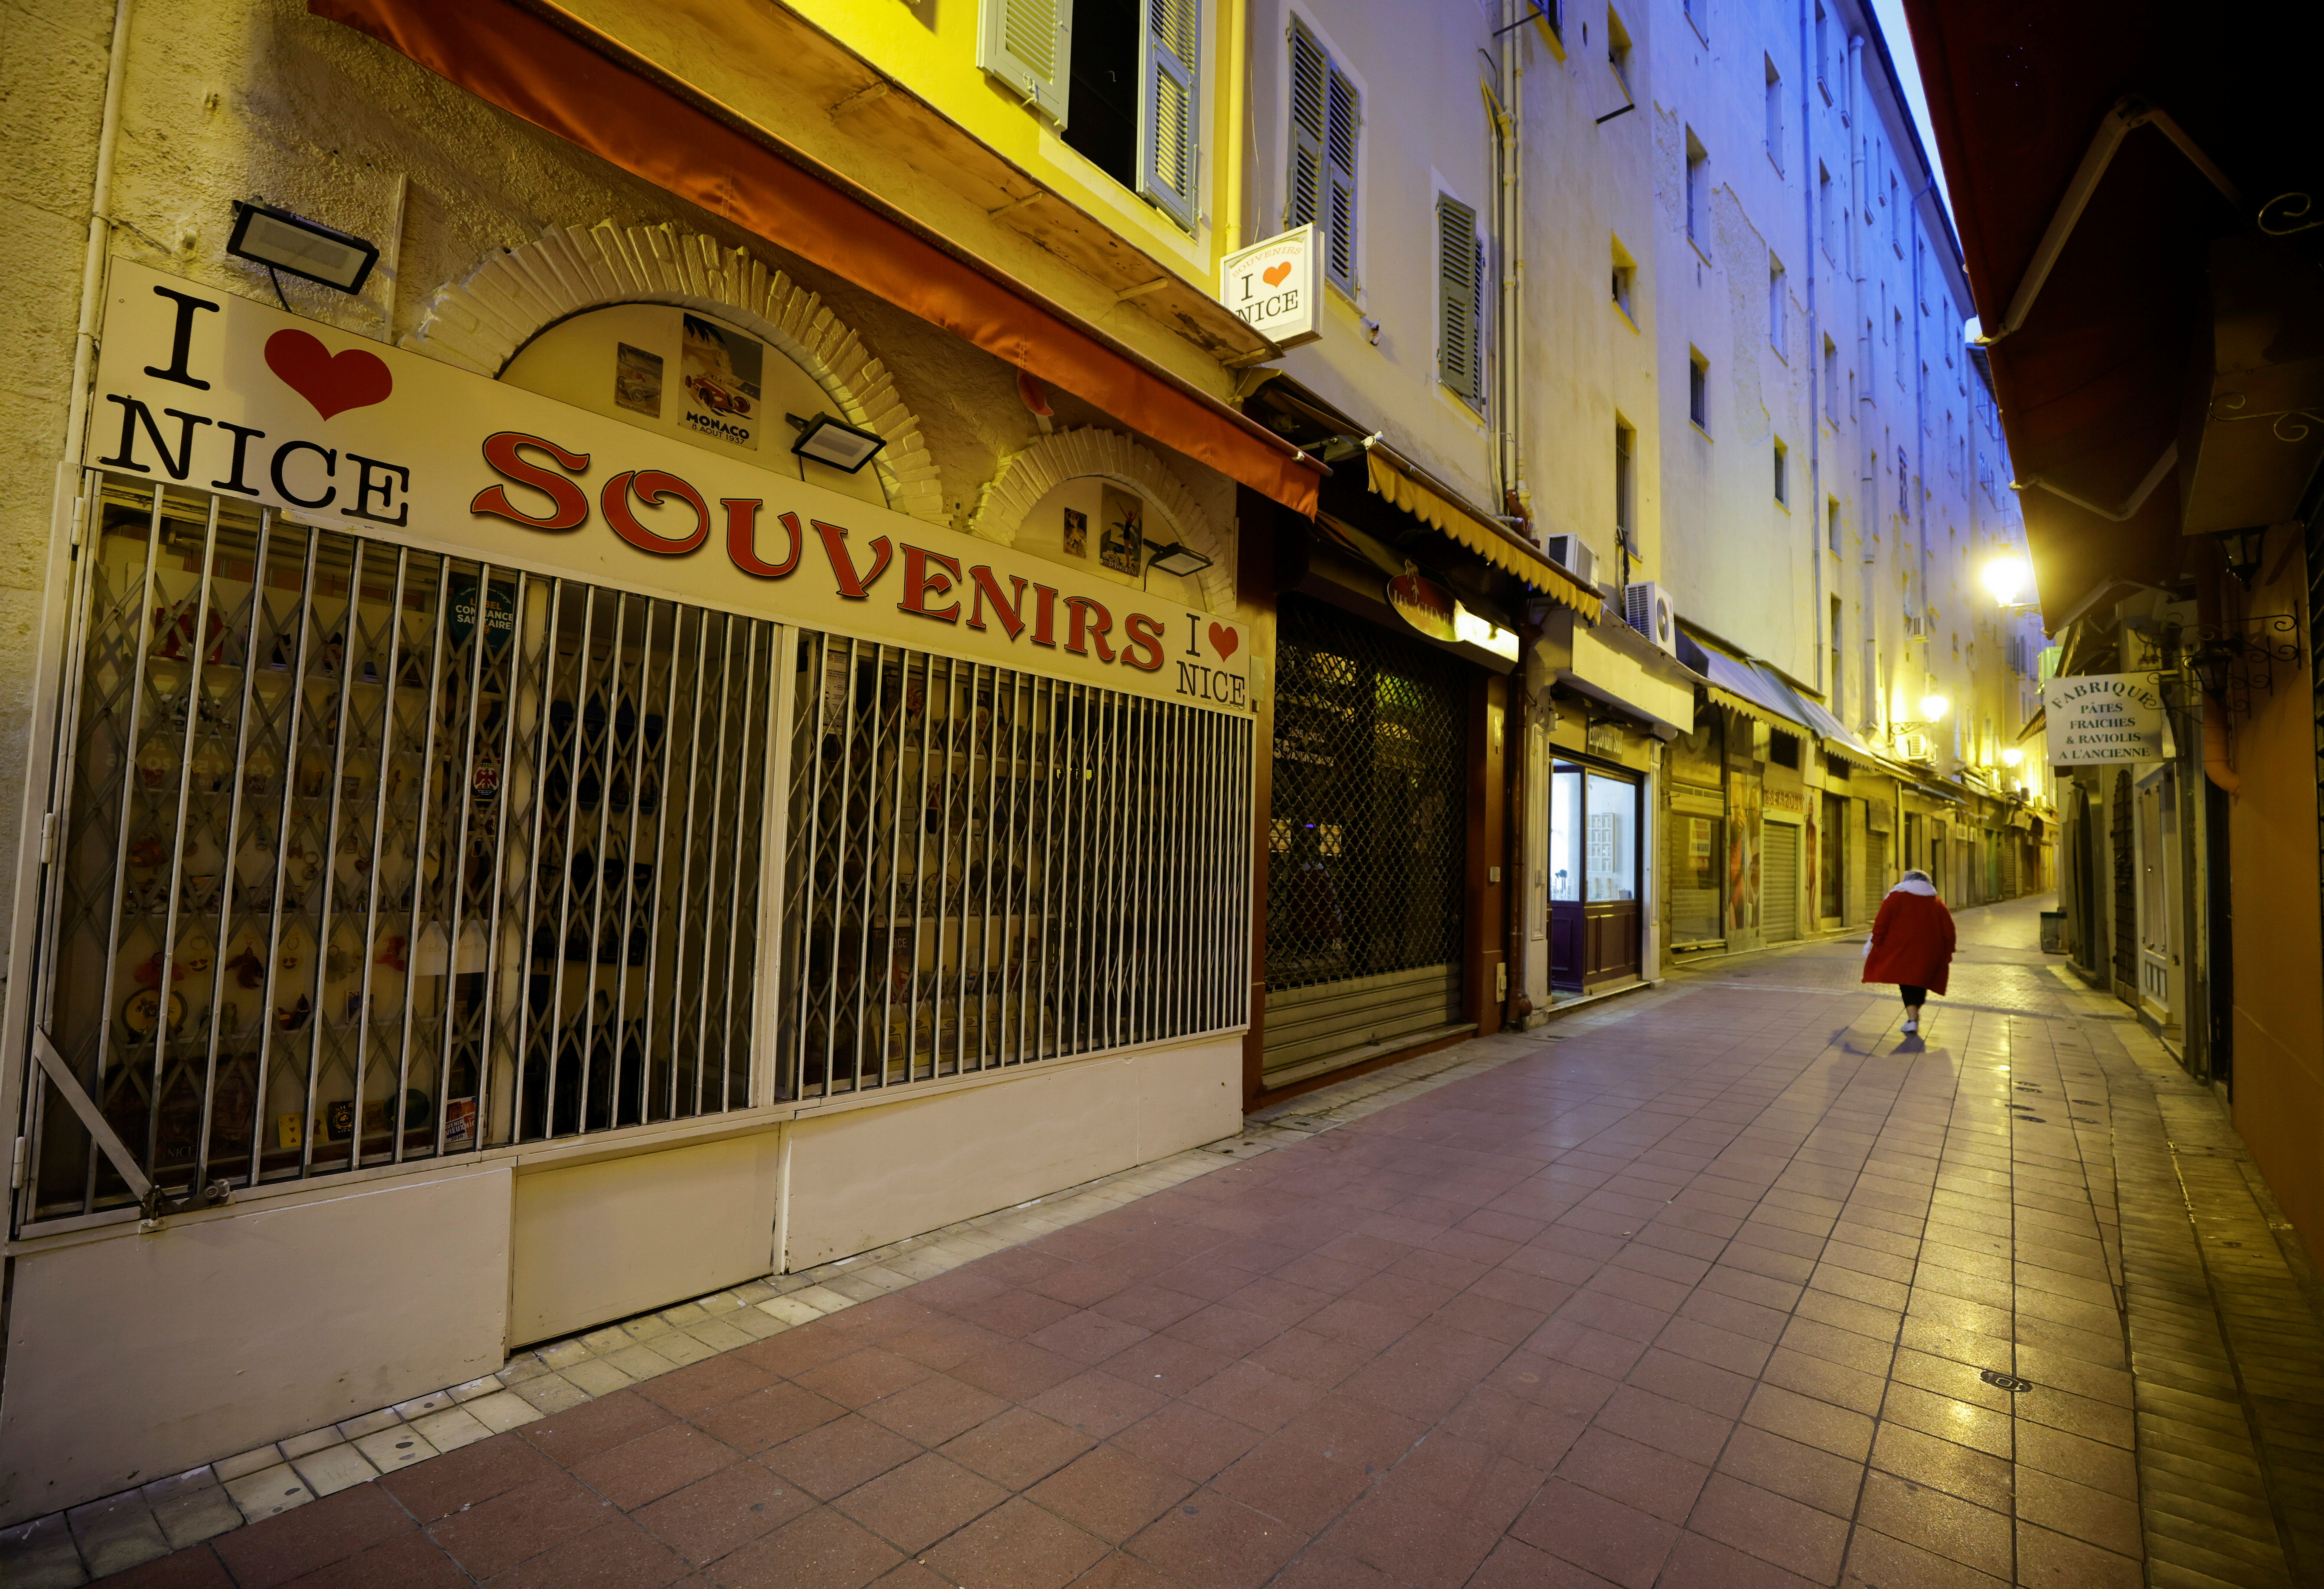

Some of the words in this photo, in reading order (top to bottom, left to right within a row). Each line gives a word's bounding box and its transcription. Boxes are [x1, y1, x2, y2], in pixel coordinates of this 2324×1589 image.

[1232, 246, 1302, 278] SOUVENIRS
[1241, 273, 1253, 301] I
[1236, 289, 1298, 324] NICE
[144, 285, 220, 391] I
[686, 411, 749, 439] MONACO
[699, 426, 723, 438] AOUT
[726, 434, 745, 444] 1937
[98, 394, 409, 527] NICE
[470, 431, 1165, 670] SOUVENIRS
[455, 605, 513, 621] CONIANCE
[470, 598, 502, 611] LBEL
[457, 614, 512, 630] SATAIRE
[1186, 613, 1200, 657] I
[1176, 660, 1244, 707] NICE
[2052, 681, 2154, 709] FABRIQUE
[2081, 701, 2123, 714] PÂTES
[2070, 717, 2136, 729] FRAICHES
[2066, 736, 2074, 744] &
[2079, 732, 2142, 743] RAVIOLIS
[2059, 751, 2068, 759] A
[2072, 747, 2150, 759] L'ANCIENNE
[1767, 789, 1804, 808] SEAFOLLY
[894, 938, 908, 948] ICE
